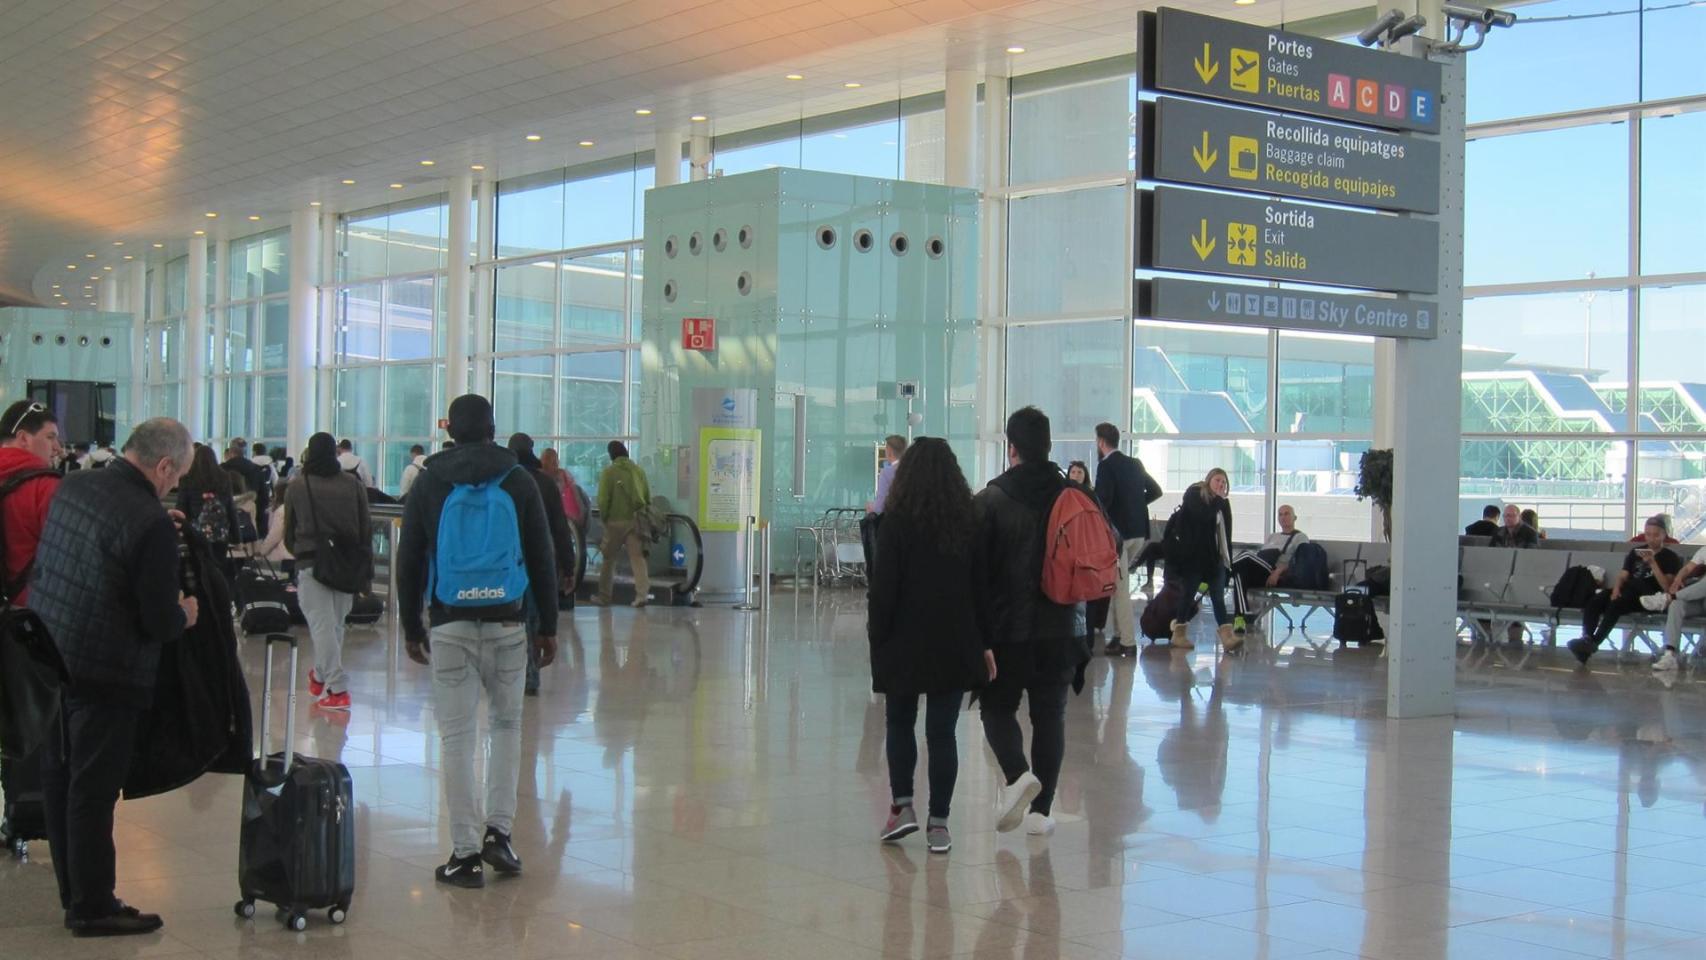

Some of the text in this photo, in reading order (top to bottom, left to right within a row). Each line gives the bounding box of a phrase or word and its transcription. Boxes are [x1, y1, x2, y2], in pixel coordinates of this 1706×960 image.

[1268, 34, 1313, 59] Portes
[1267, 59, 1299, 77] Gates
[1267, 77, 1320, 102] Puertas
[1333, 81, 1426, 117] A C D E
[1267, 121, 1405, 159] Recollida equipatges
[1266, 143, 1345, 168] Baggage claim
[1266, 164, 1396, 198] Recogida equipajes
[1265, 206, 1315, 228] Sortida
[1265, 229, 1285, 245] Exit
[1264, 249, 1307, 270] Salida
[1318, 301, 1408, 328] Sky Centre
[457, 586, 505, 600] adidas
